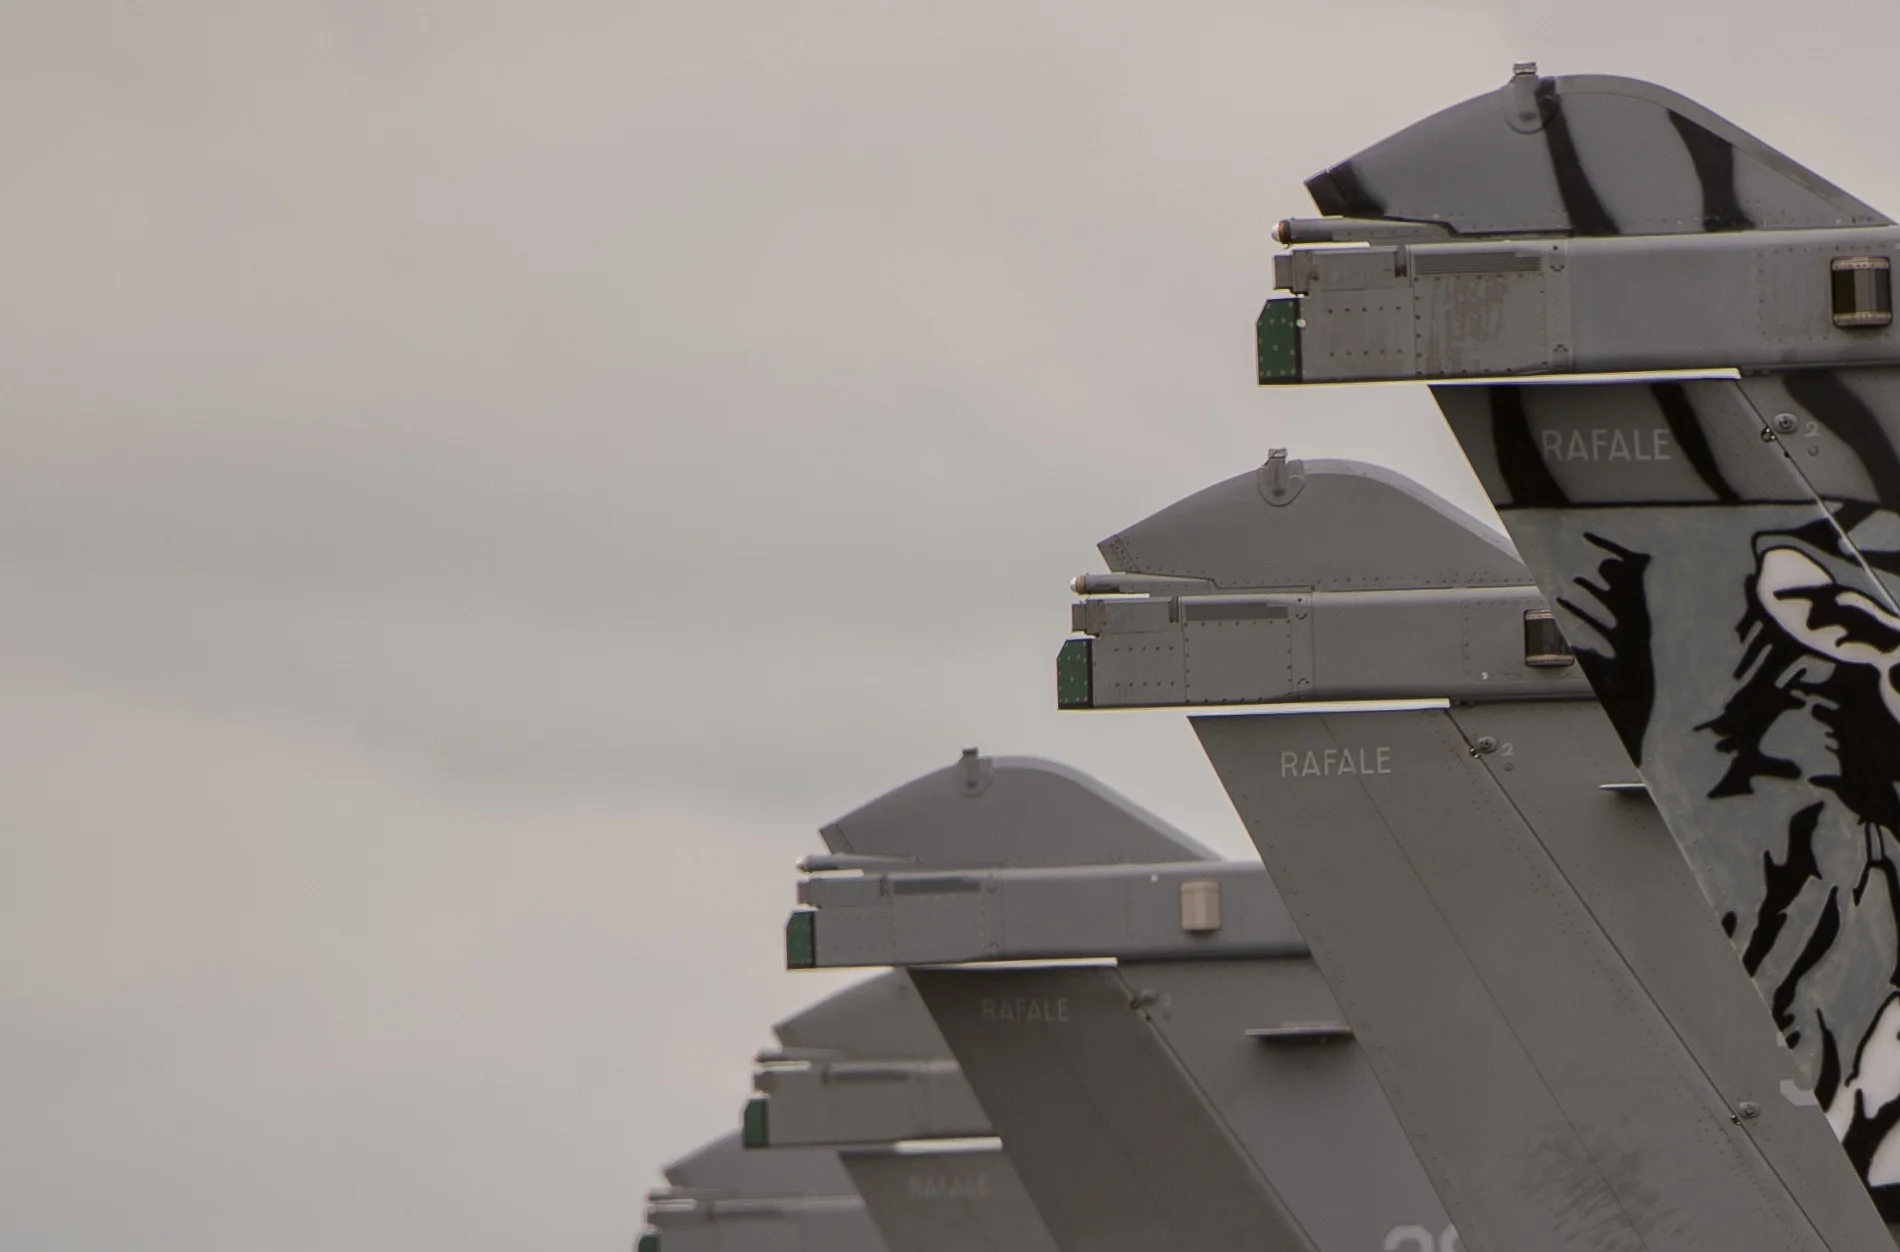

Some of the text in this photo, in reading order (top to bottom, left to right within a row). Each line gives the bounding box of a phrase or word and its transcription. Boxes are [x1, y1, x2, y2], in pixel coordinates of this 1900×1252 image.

[1804, 422, 1820, 438] 2
[1541, 429, 1673, 461] RAFALE
[1280, 747, 1392, 777] RAFALE
[1501, 743, 1514, 756] 2
[981, 997, 1070, 1023] RAFALE
